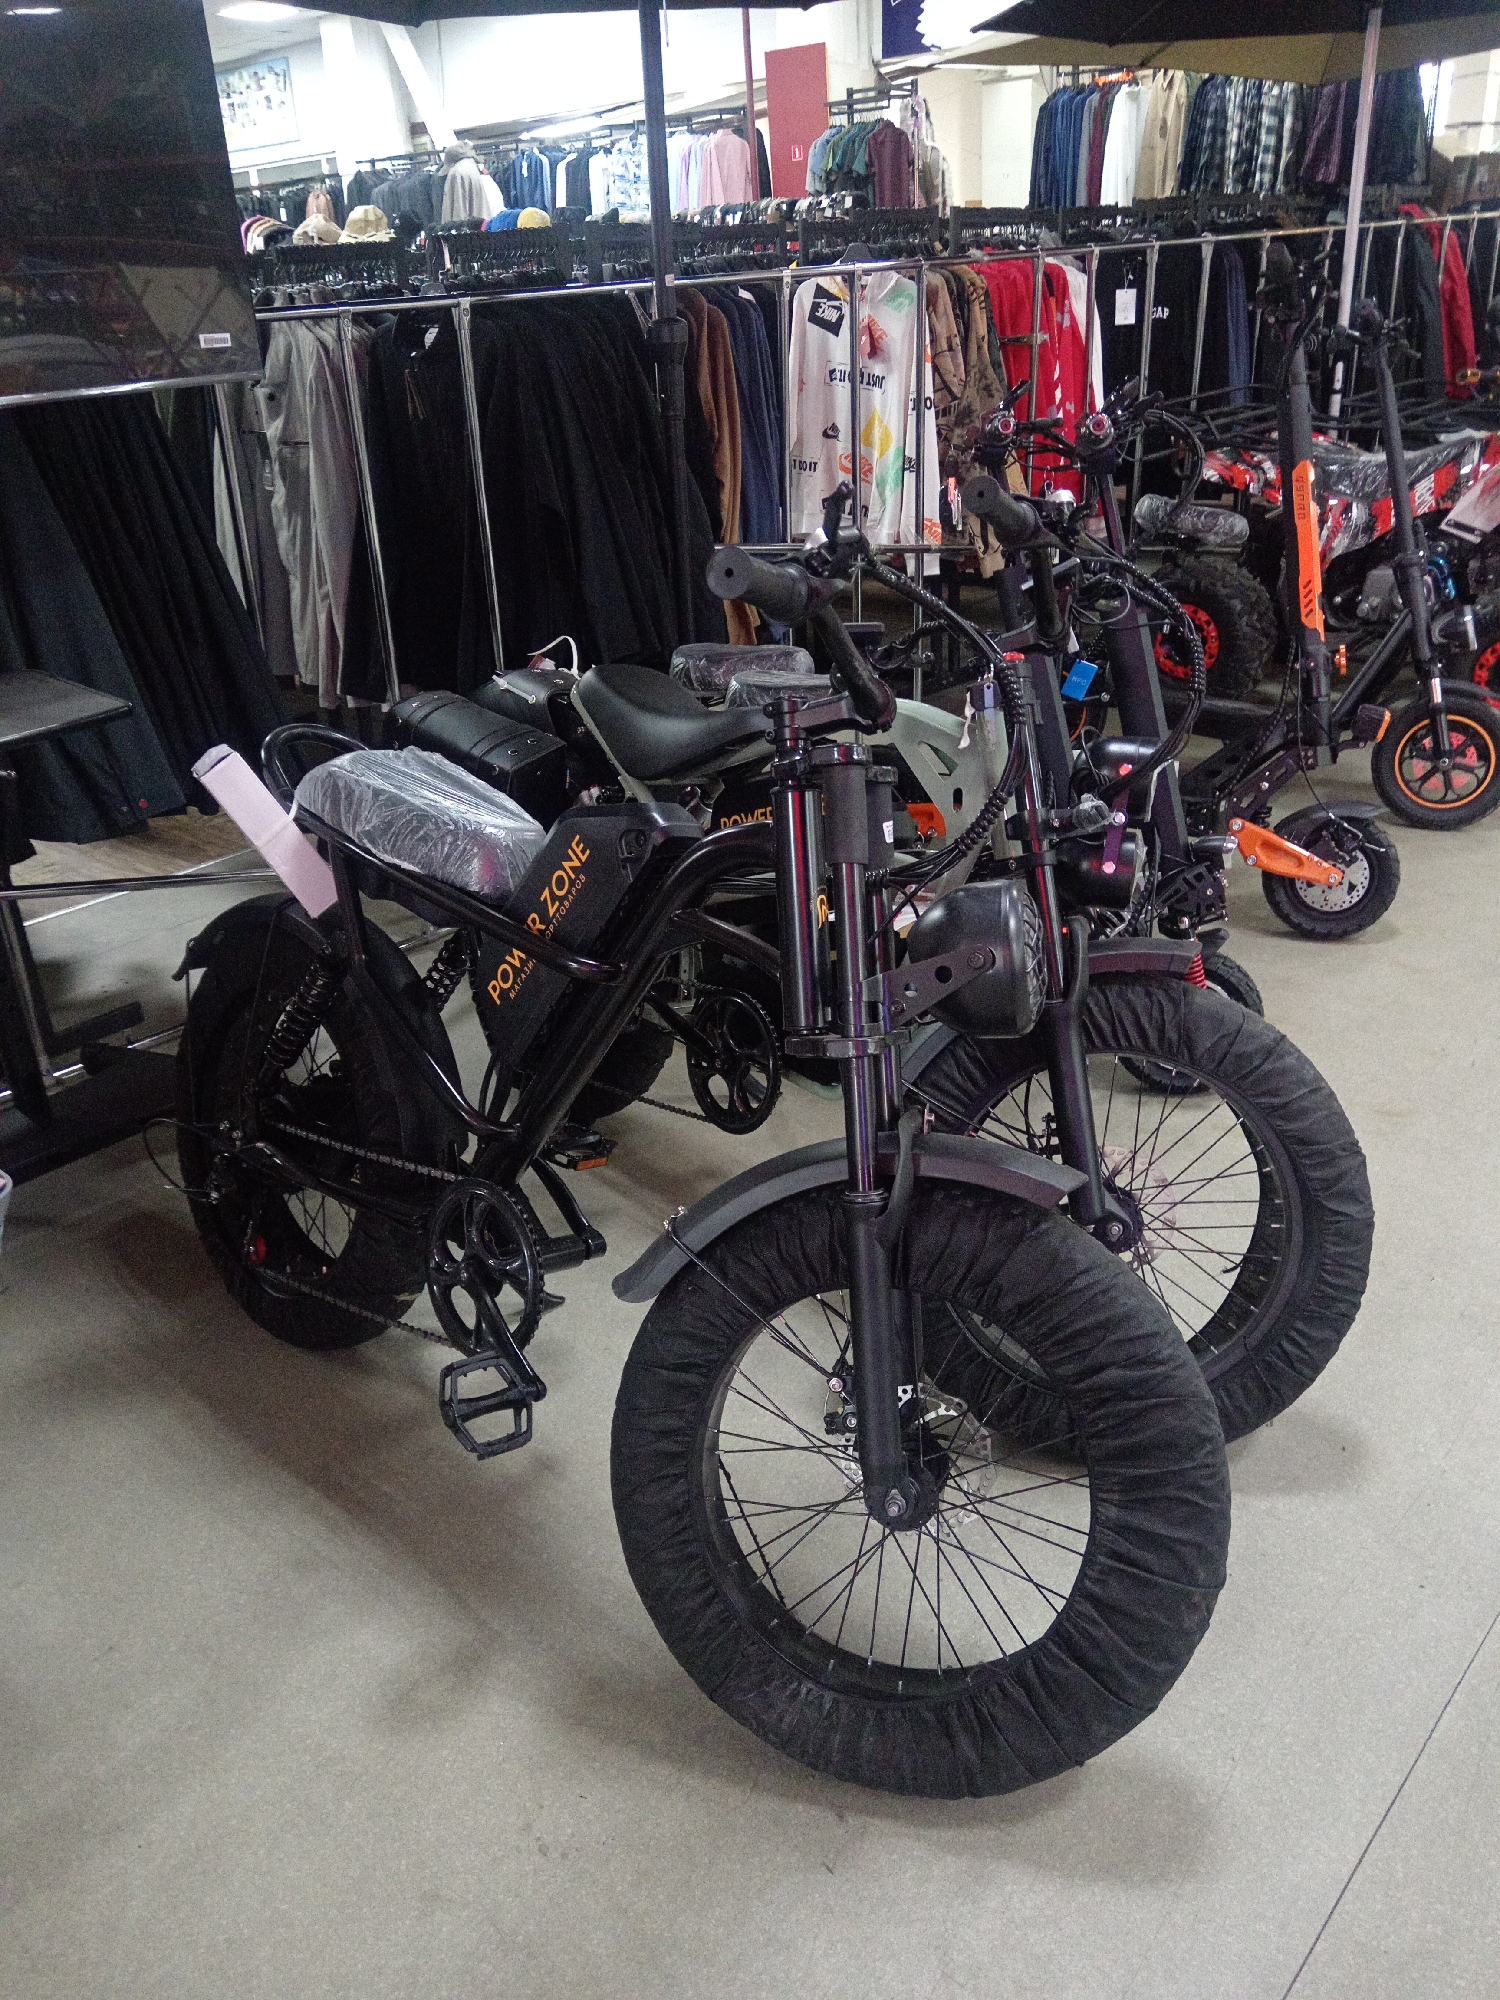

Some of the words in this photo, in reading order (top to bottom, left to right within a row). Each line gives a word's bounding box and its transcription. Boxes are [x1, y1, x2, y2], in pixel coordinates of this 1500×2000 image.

[815, 304, 841, 323] NIKE
[866, 372, 885, 389] JUST
[540, 834, 591, 917] ZONE
[508, 958, 537, 1000] МАГАЗИ
